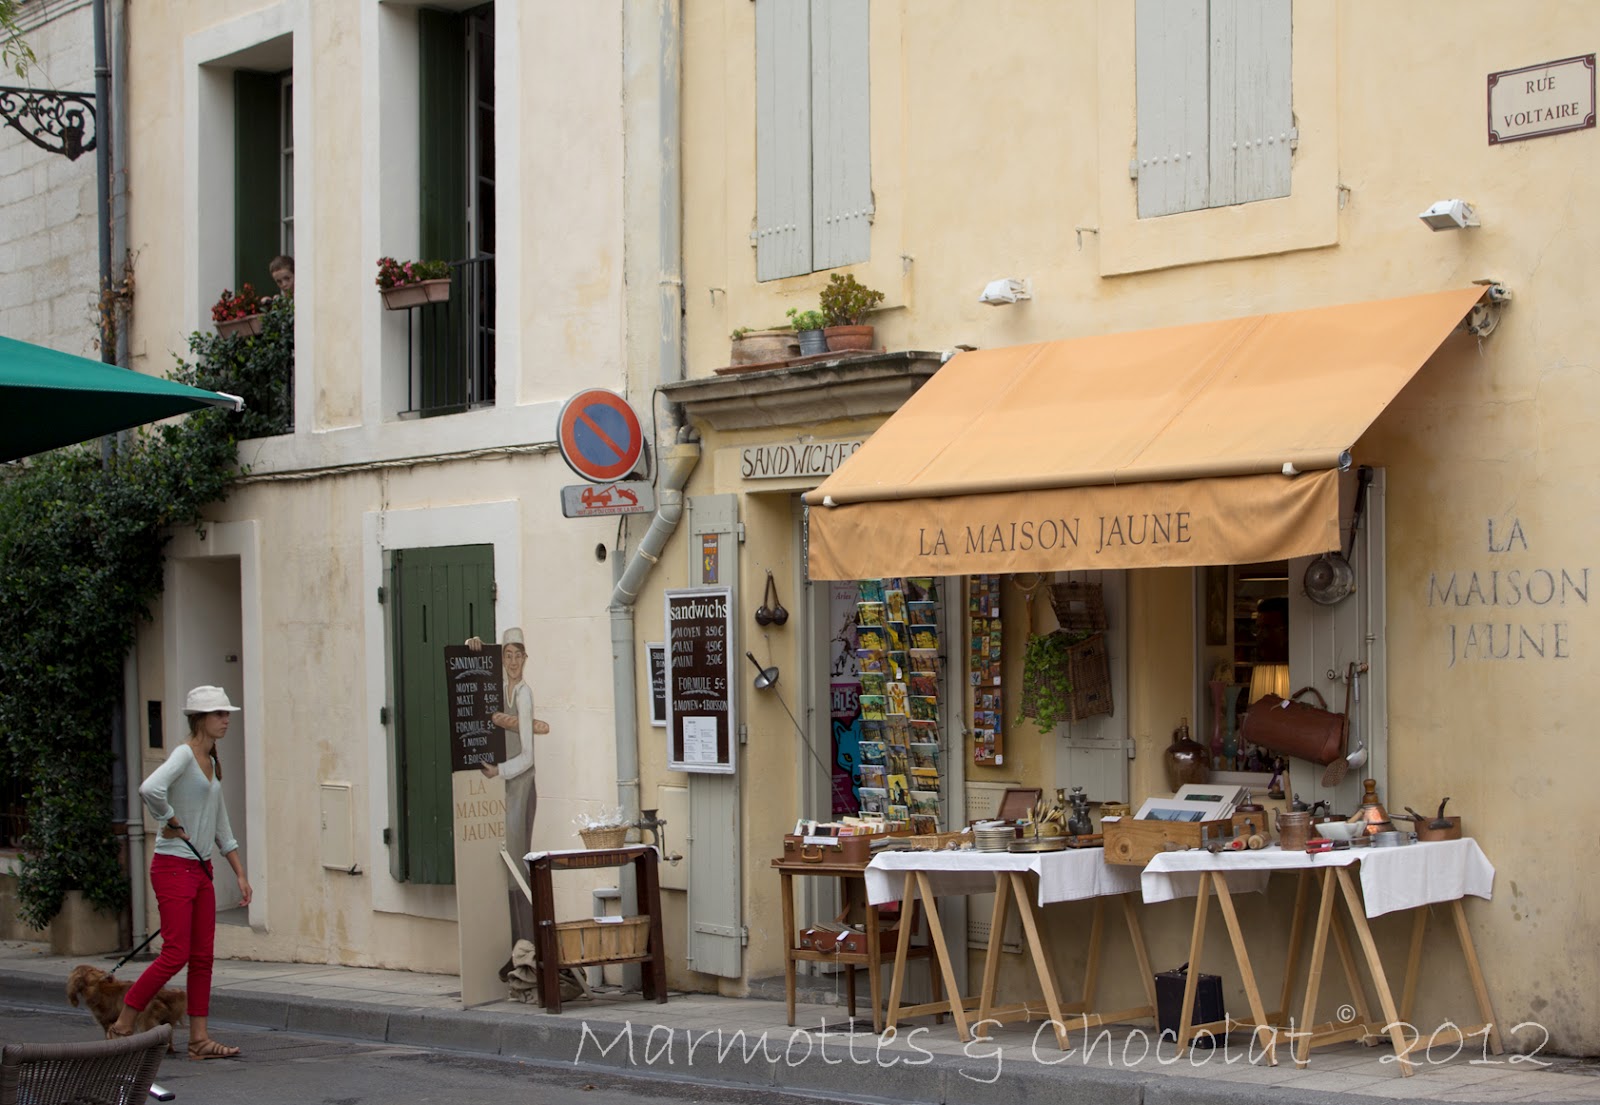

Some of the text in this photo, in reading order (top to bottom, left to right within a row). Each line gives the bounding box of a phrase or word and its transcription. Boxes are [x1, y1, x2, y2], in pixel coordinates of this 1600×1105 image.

[1526, 76, 1555, 94] RUE
[1504, 102, 1579, 128] VOLTAIRE
[919, 512, 1192, 556] LA MAISON JAUNE
[1487, 518, 1528, 553] LA
[1427, 568, 1589, 607] MAISON
[670, 599, 727, 620] sandwichs
[1448, 620, 1569, 669] JAUNE
[450, 656, 493, 670] SANDWICHS
[456, 682, 478, 692] MOYEN
[678, 676, 711, 690] FORMULE
[456, 695, 474, 705] MAXI
[832, 690, 858, 711] RLES
[457, 706, 473, 717] MINI
[456, 720, 485, 733] FORMULE
[469, 780, 486, 795] LA
[456, 800, 508, 819] MAISON
[463, 821, 505, 841] JAUNE
